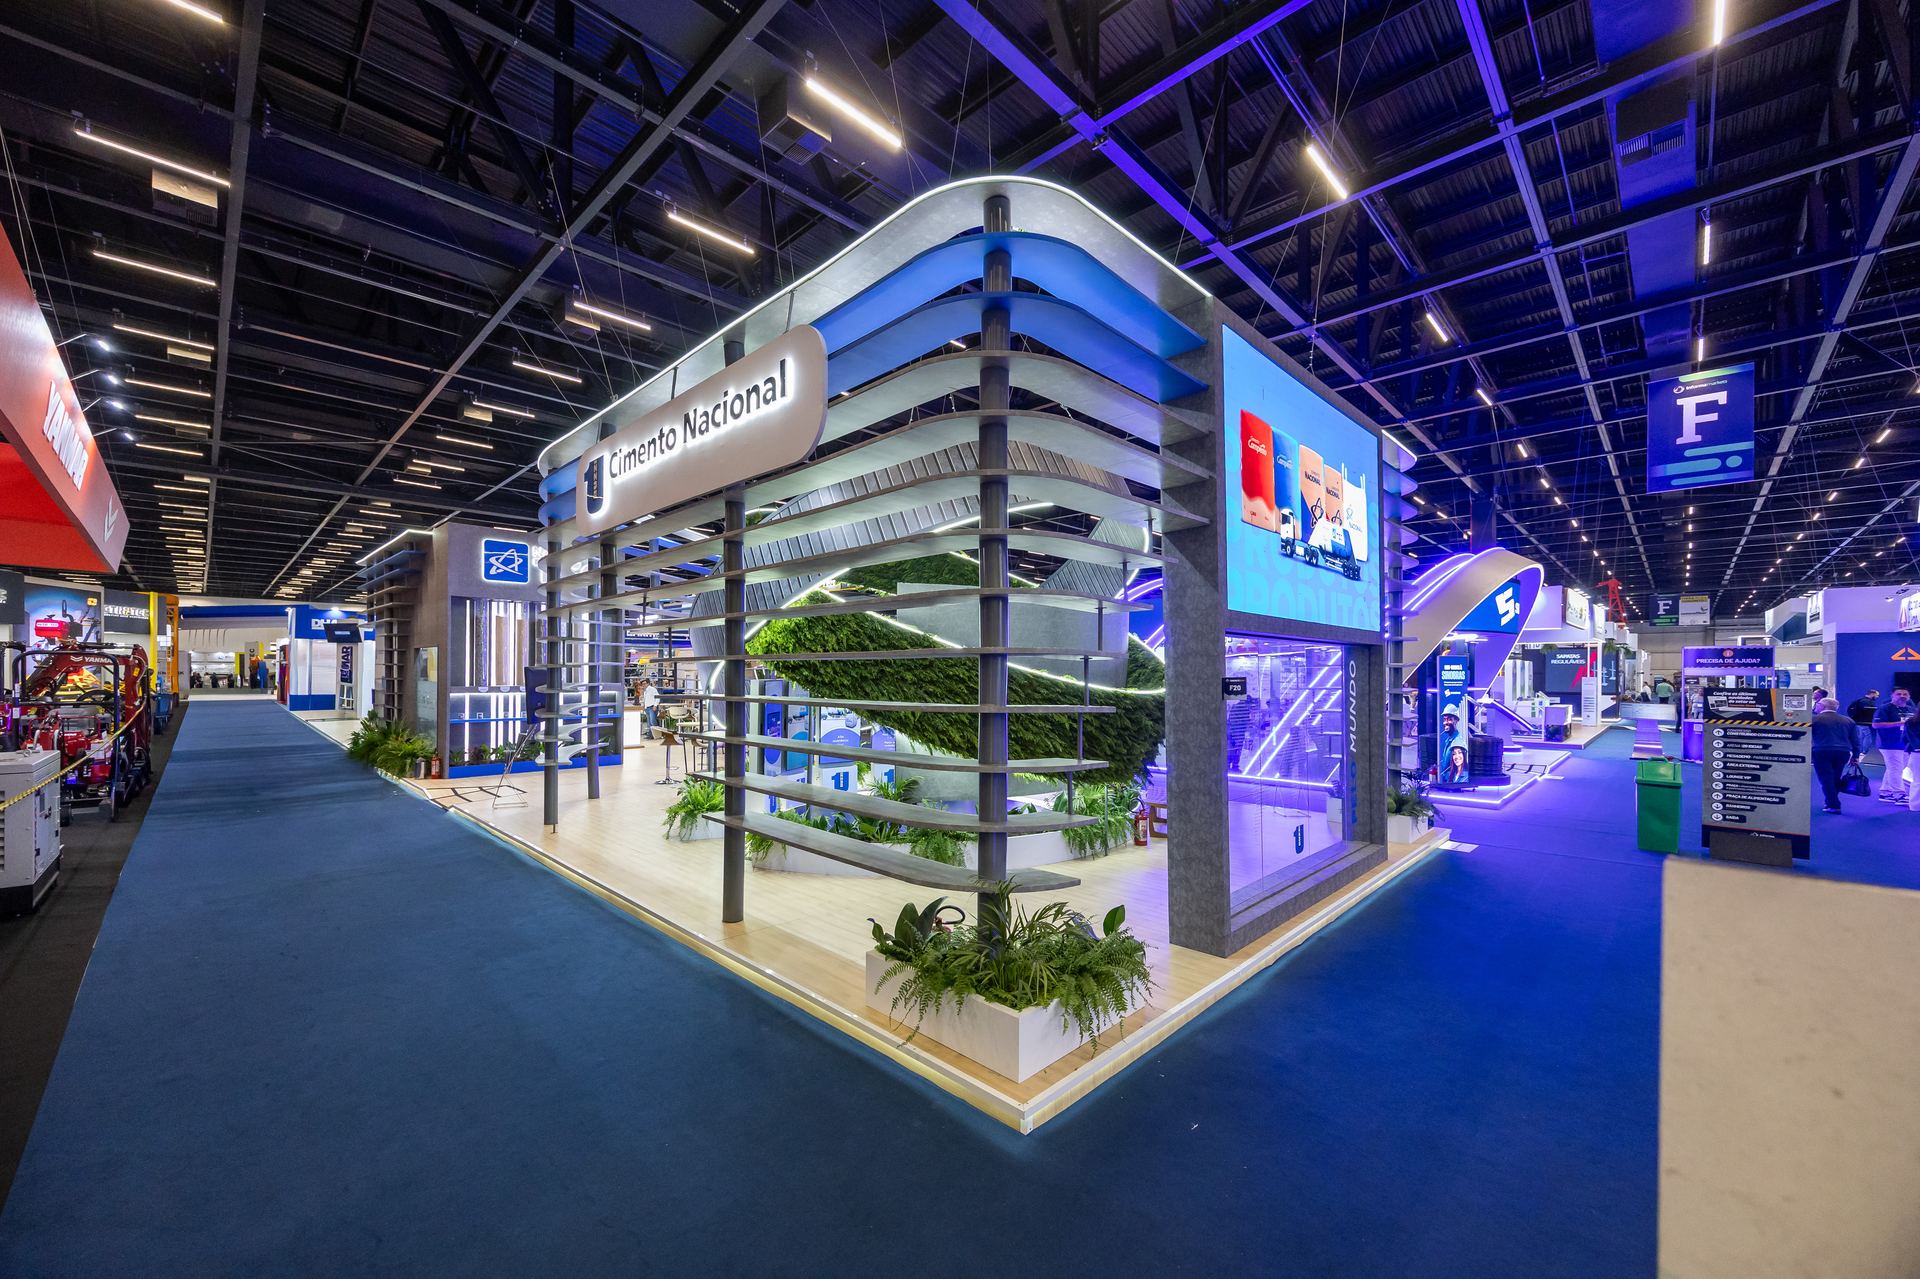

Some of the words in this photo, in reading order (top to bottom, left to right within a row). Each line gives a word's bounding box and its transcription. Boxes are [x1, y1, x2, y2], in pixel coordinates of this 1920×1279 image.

[609, 427, 676, 478] Cimento
[683, 358, 787, 443] Nacional
[1676, 391, 1728, 444] F
[1657, 600, 1672, 614] F
